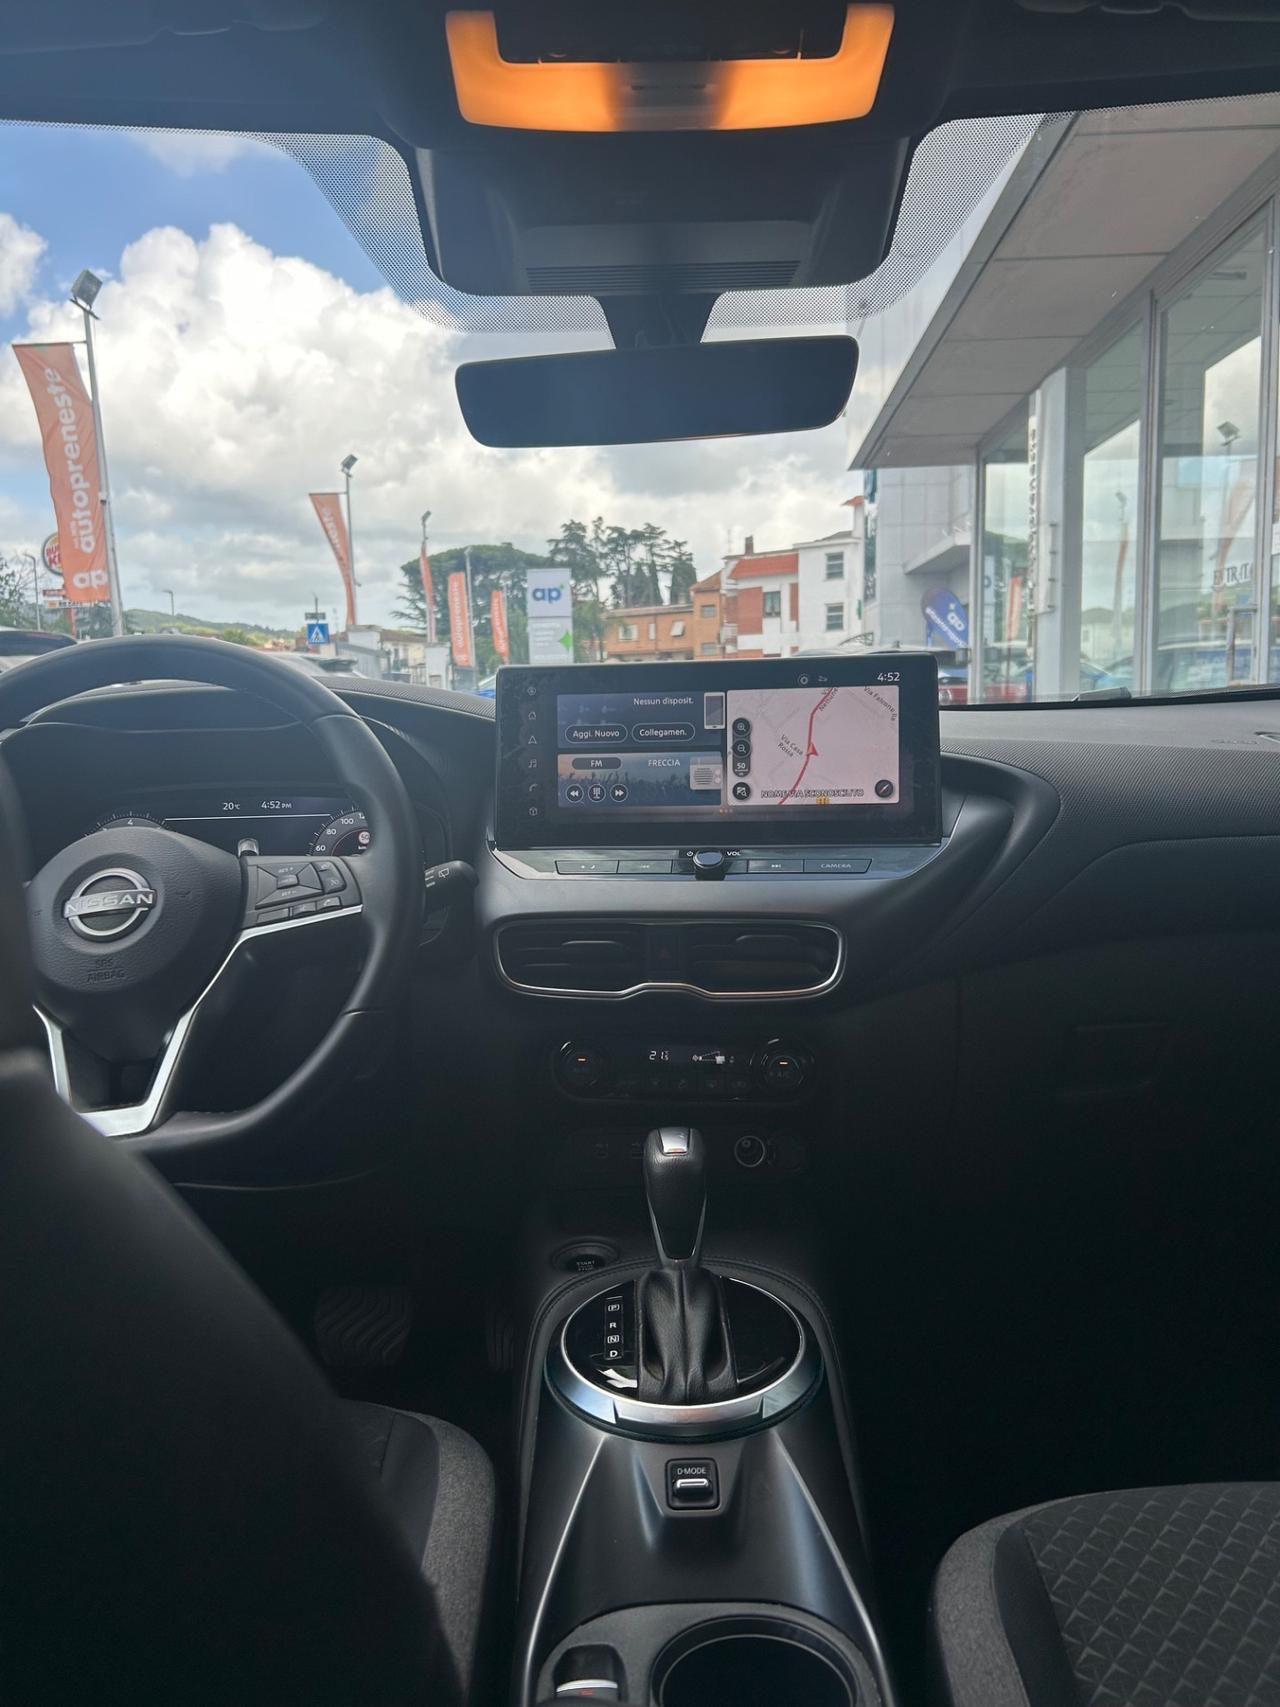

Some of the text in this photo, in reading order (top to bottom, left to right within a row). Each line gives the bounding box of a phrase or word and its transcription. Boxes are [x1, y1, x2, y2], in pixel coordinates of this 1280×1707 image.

[45, 367, 96, 554] autopreneste
[532, 586, 562, 604] ap
[877, 672, 900, 682] 4:52
[633, 696, 694, 706] Nessun disposit.
[594, 729, 620, 738] Nuovo
[639, 728, 687, 738] Collegamen.
[590, 759, 603, 768] FM
[647, 759, 681, 767] FRECCIA
[261, 800, 281, 809] 4:52
[315, 844, 326, 852] 60
[65, 893, 153, 914] NISSAN
[609, 1350, 618, 1358] D
